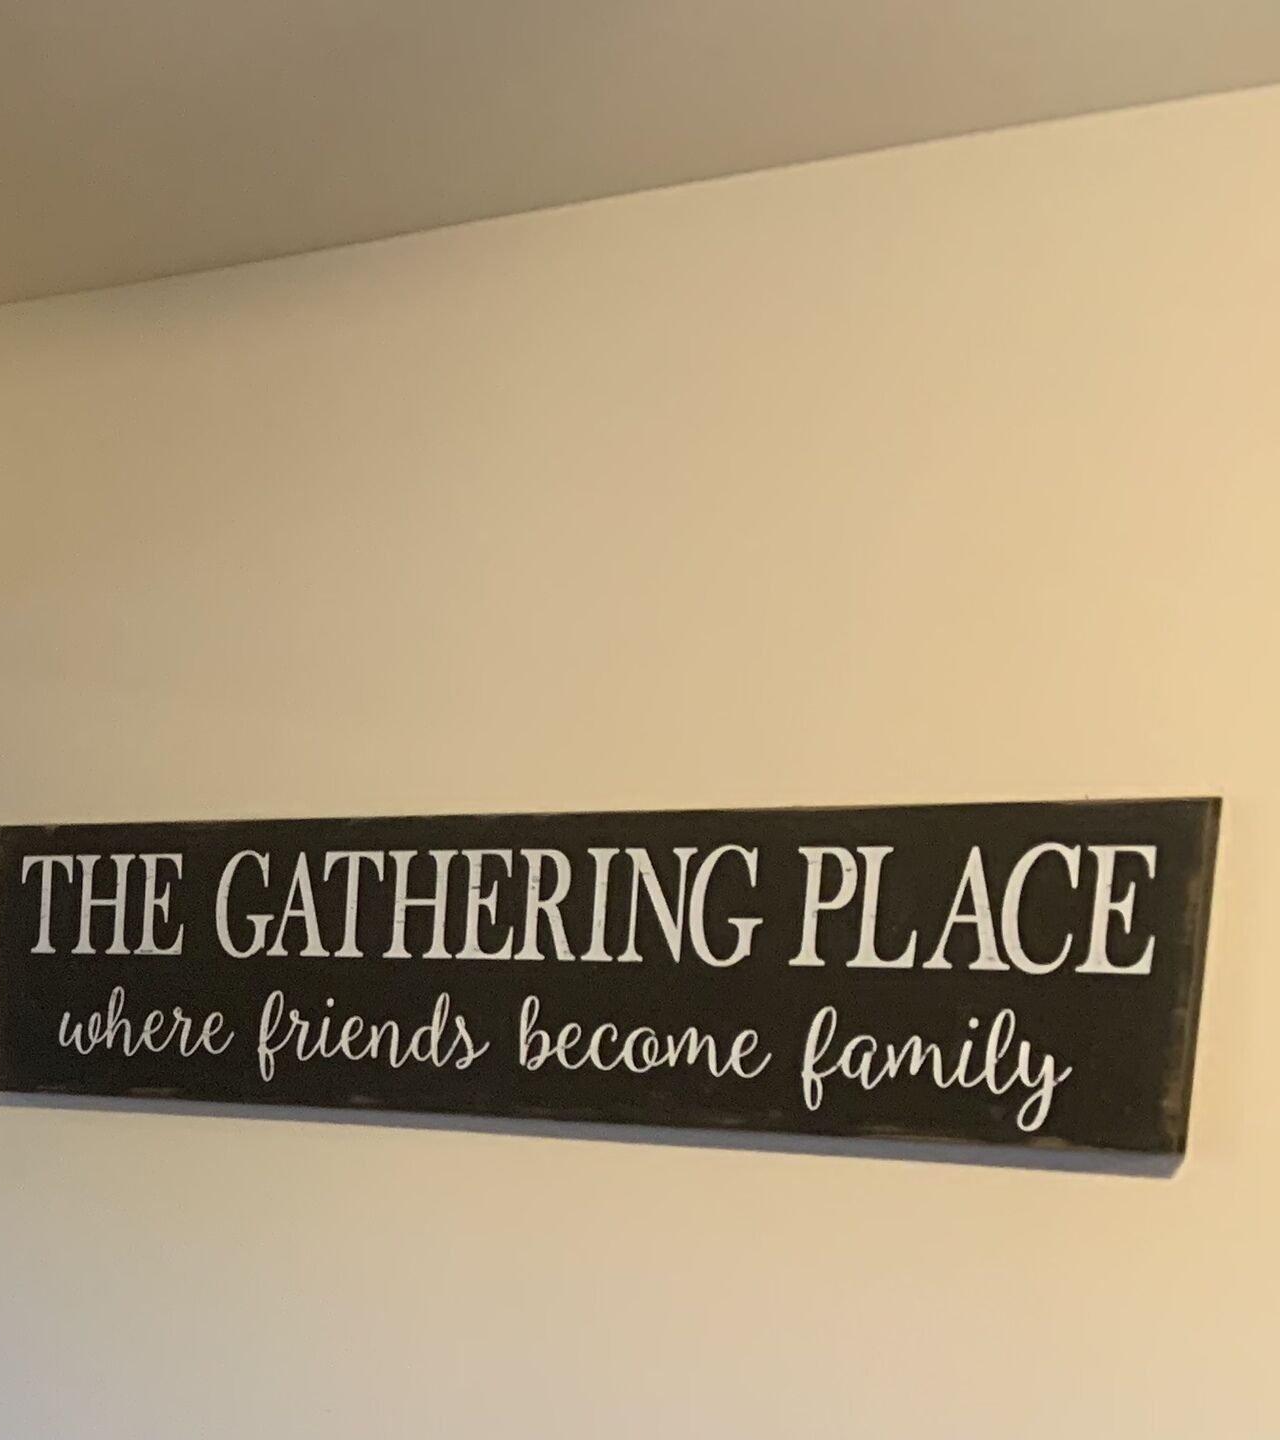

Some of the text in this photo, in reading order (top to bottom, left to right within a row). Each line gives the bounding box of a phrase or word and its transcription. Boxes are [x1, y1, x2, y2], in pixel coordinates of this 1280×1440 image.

[21, 842, 1157, 976] THE GATHERING PLACE
[58, 986, 1072, 1132] where friends become family
